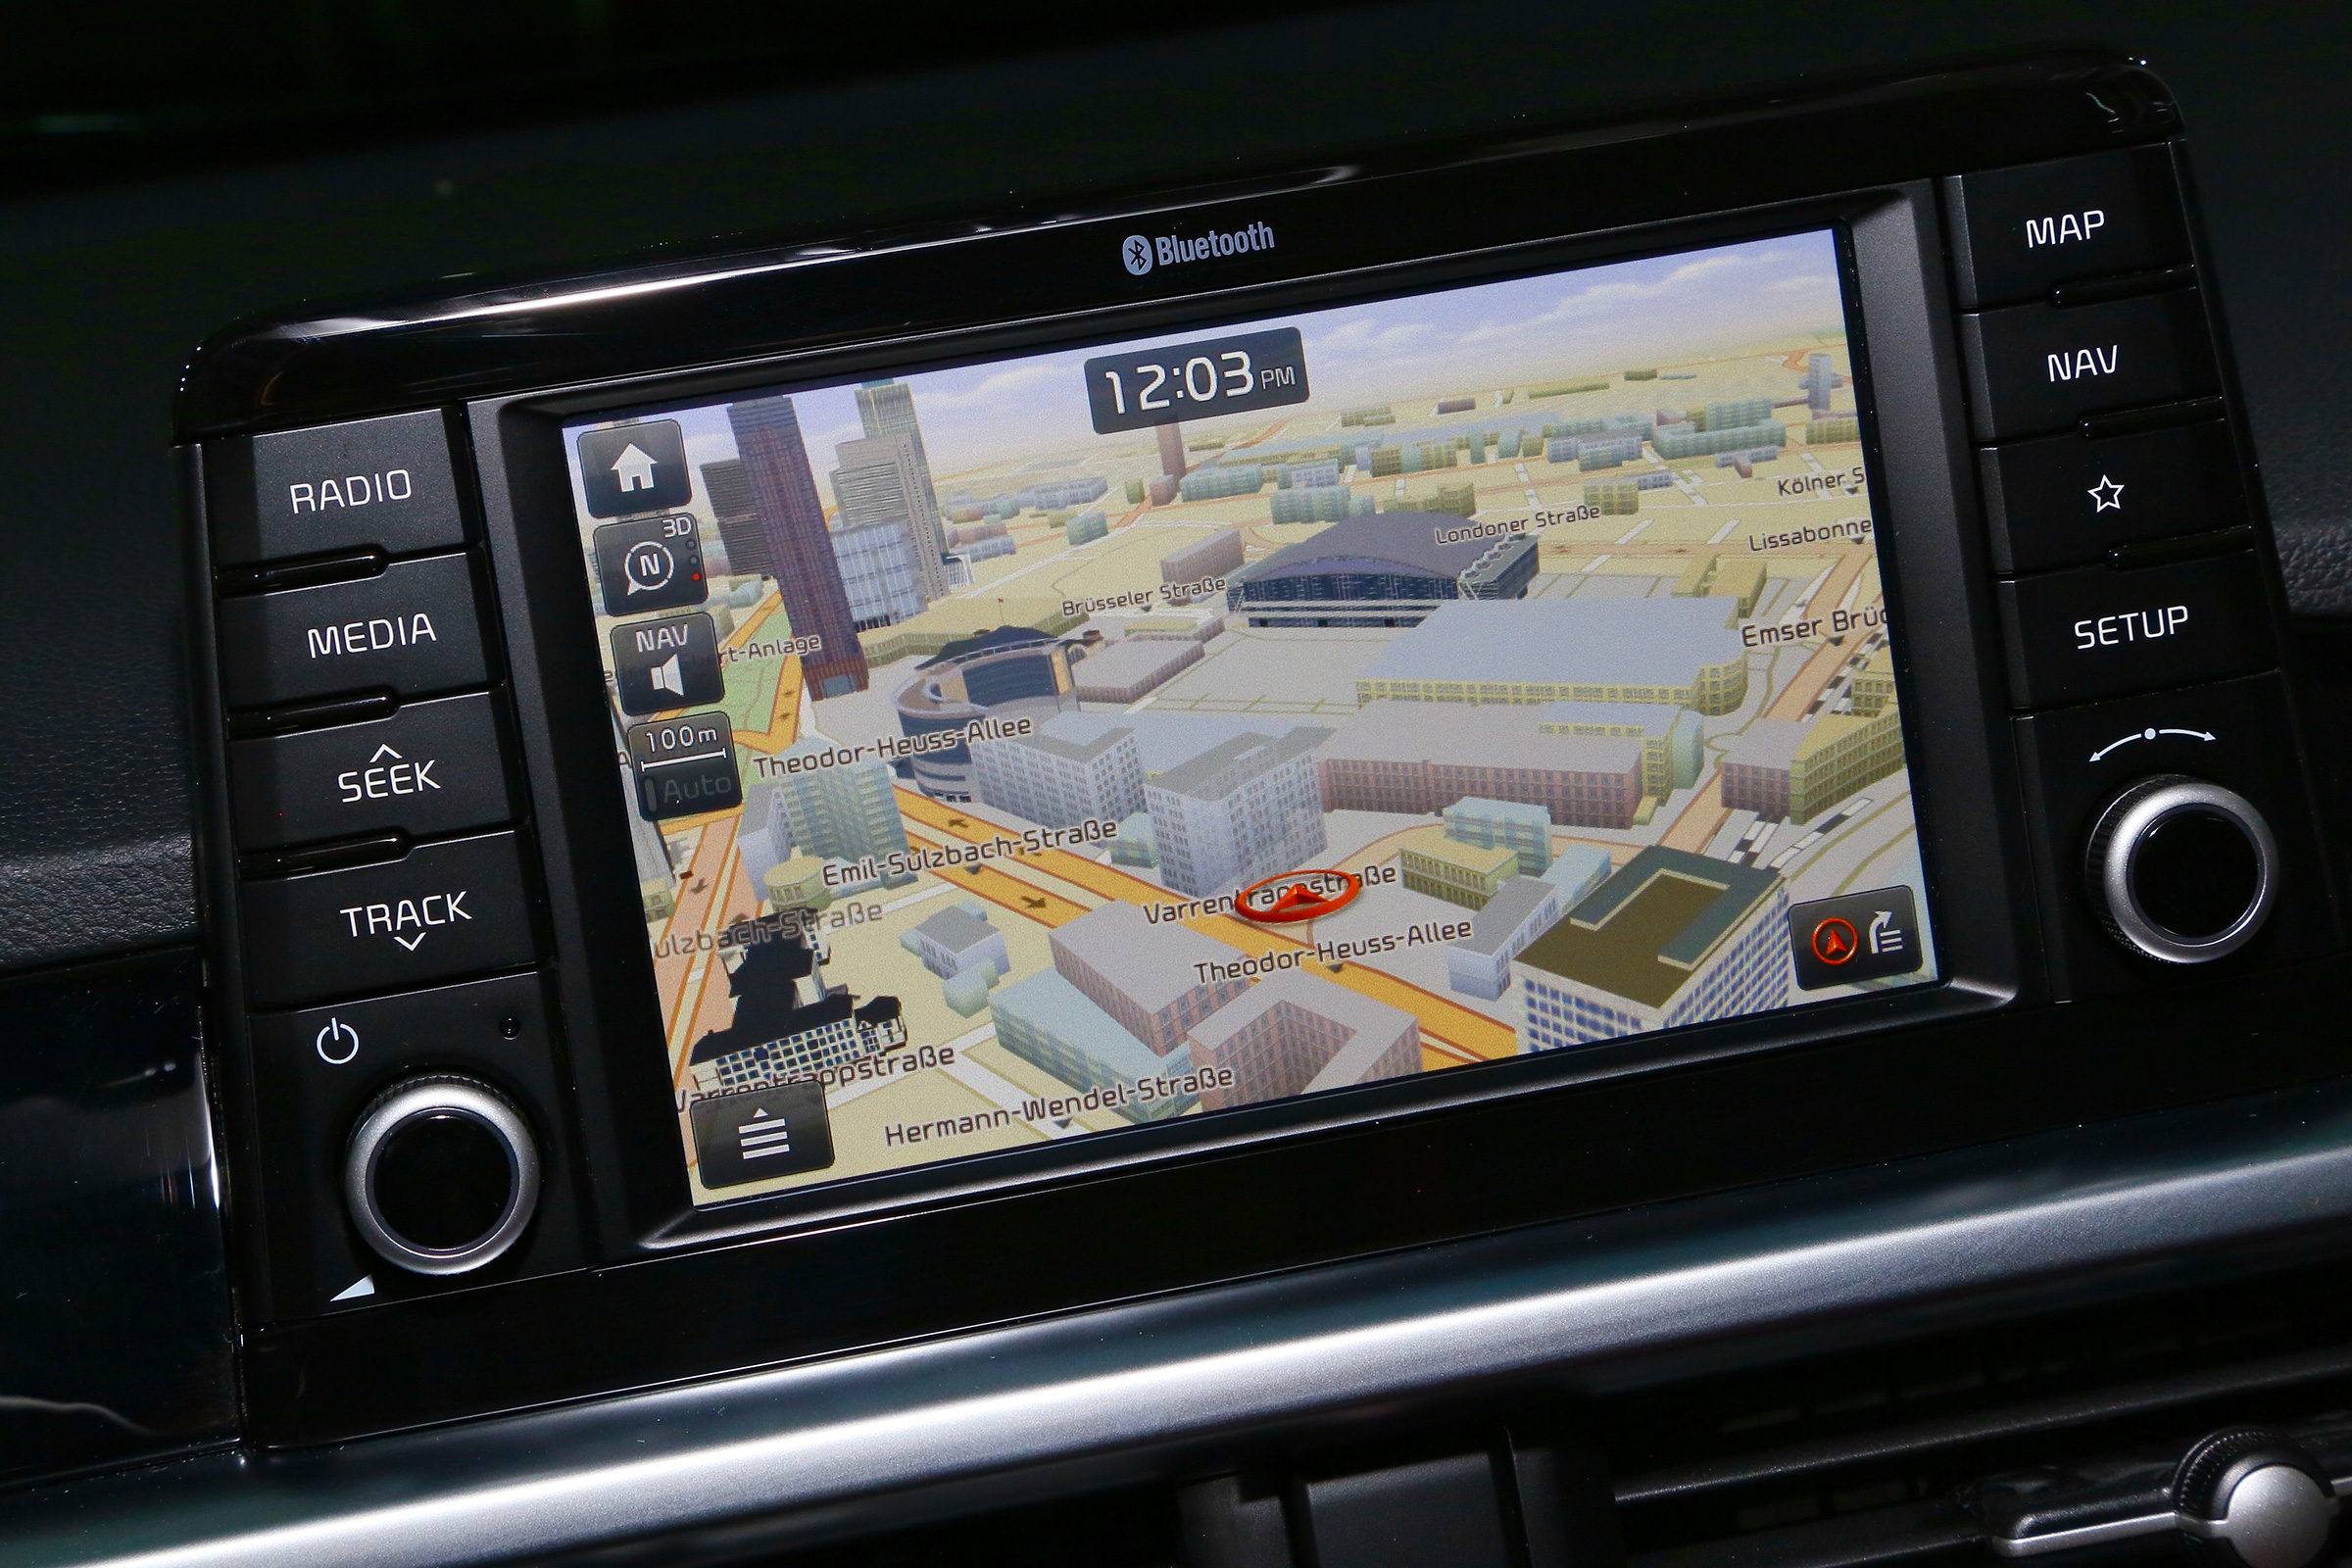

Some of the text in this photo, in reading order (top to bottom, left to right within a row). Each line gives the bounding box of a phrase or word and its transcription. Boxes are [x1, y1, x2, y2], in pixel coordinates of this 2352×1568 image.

[1155, 221, 1275, 267] Bluetooth
[2026, 210, 2105, 249] MAP
[1105, 350, 1296, 416] 12:03 PM
[2047, 345, 2118, 382] NAV
[289, 468, 412, 514] RADIO
[1778, 472, 1845, 497] Kölner
[662, 516, 692, 538] 3D
[1435, 505, 1600, 545] Londoner Straße
[1748, 519, 1872, 552] Lissabonne
[640, 553, 661, 577] N
[1062, 576, 1225, 616] Brüsseler Straße
[307, 612, 437, 659] MEDIA
[636, 623, 688, 653] NAV
[1741, 617, 1823, 648] Emser
[2074, 605, 2188, 650] SETUP
[646, 725, 717, 753] 100m
[753, 717, 1033, 779] Theodor-Heuss-Allee
[337, 760, 441, 804] SEEK
[664, 774, 731, 804] Auto
[823, 820, 1118, 886] Emil-Sulzbach-Straße
[339, 891, 472, 937] TRACK
[654, 902, 882, 958] ulzbach-Straße
[1195, 921, 1472, 984] Theodor-Heuss-Allee
[885, 1067, 1234, 1147] Hermann-Wendel-Straße
